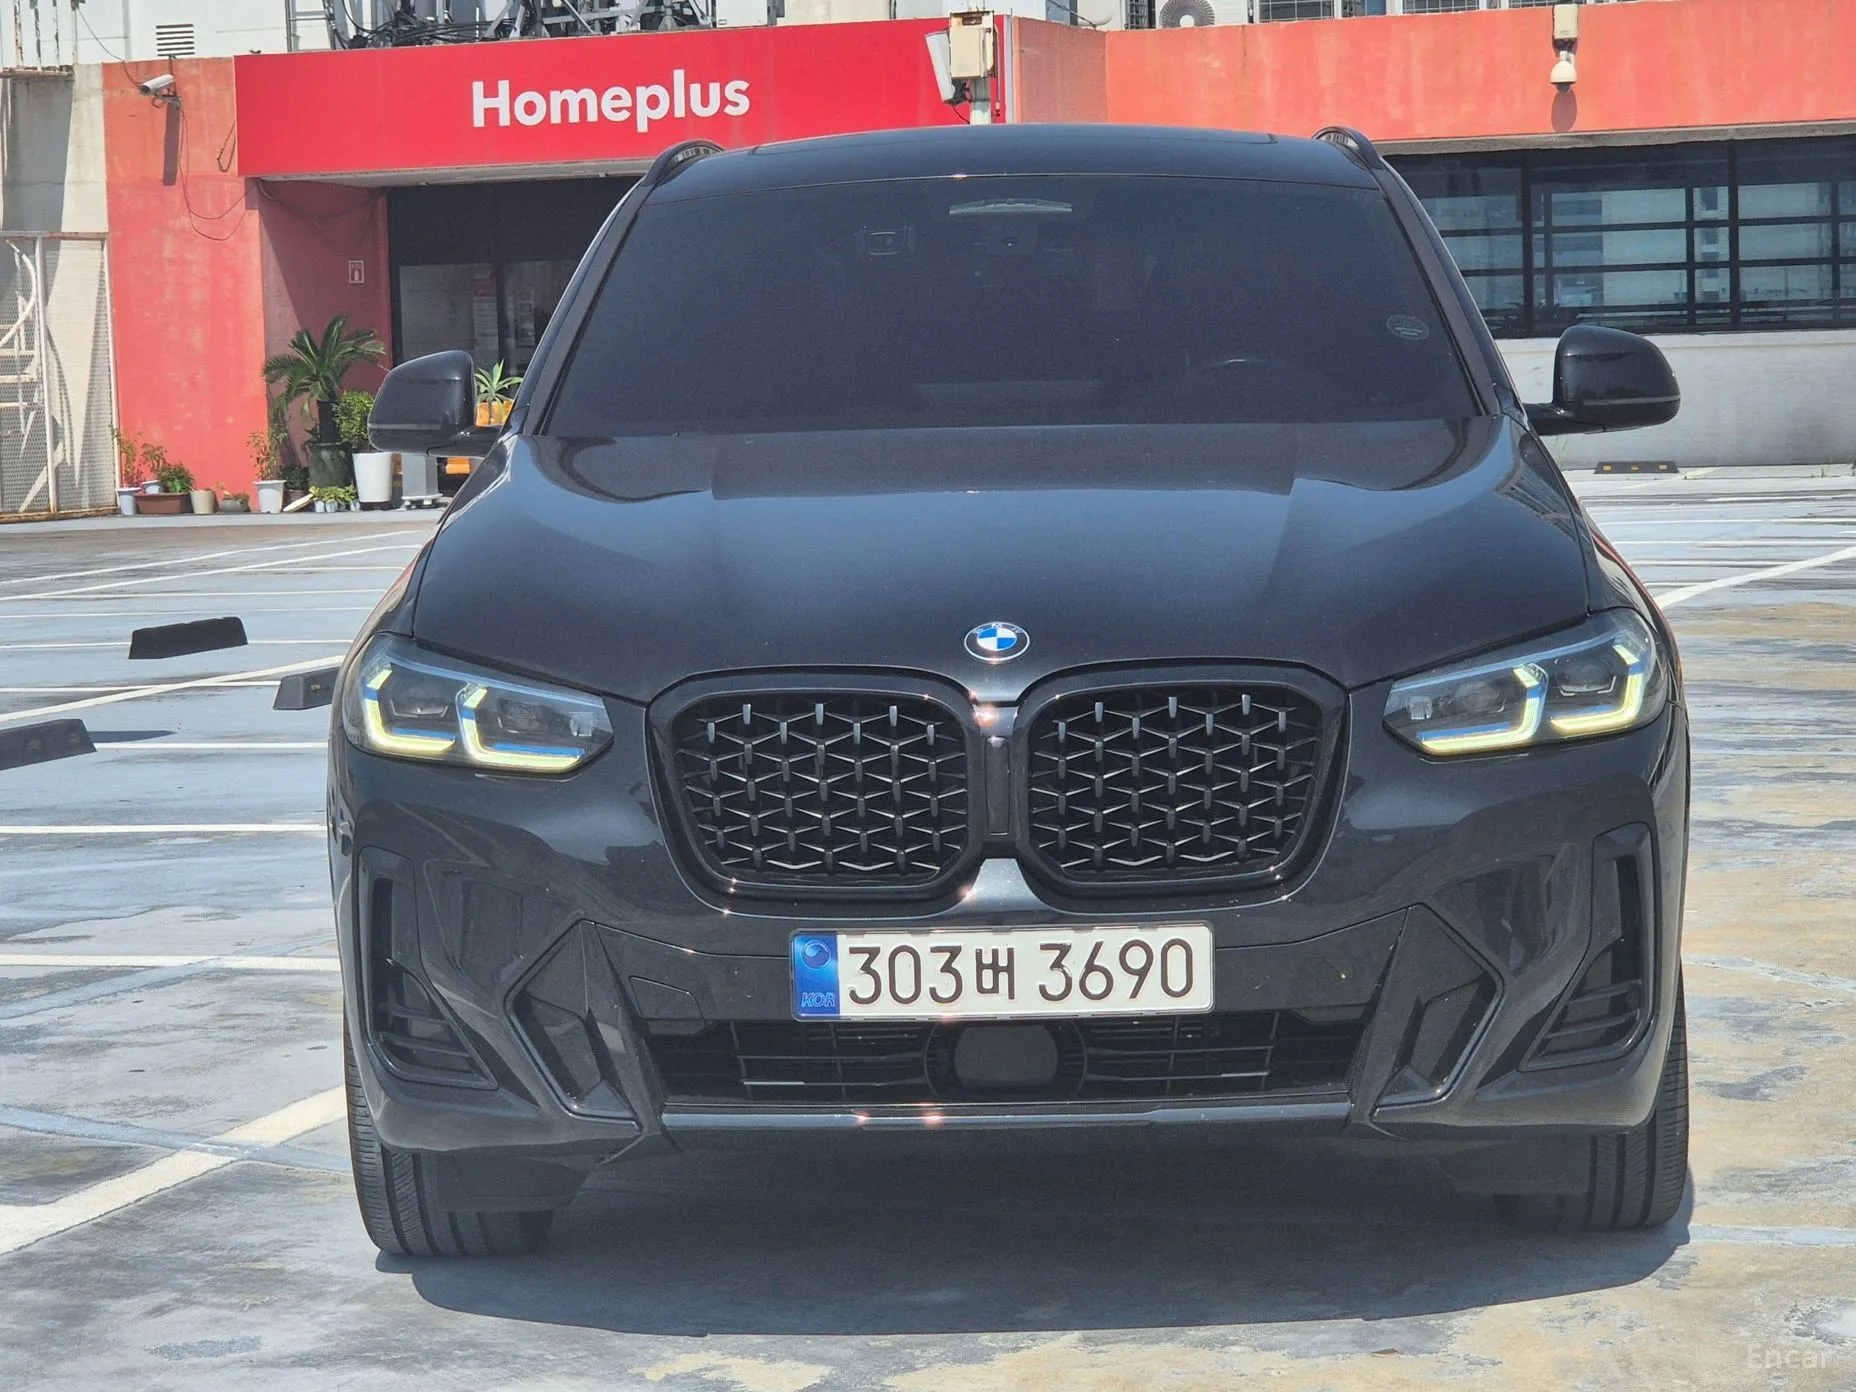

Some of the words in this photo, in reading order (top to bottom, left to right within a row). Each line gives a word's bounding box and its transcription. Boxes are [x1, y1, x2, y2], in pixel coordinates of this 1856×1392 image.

[472, 68, 751, 133] Homeplus
[801, 991, 836, 1008] KOR
[847, 943, 1015, 1005] 303버
[1038, 937, 1194, 1001] 3690
